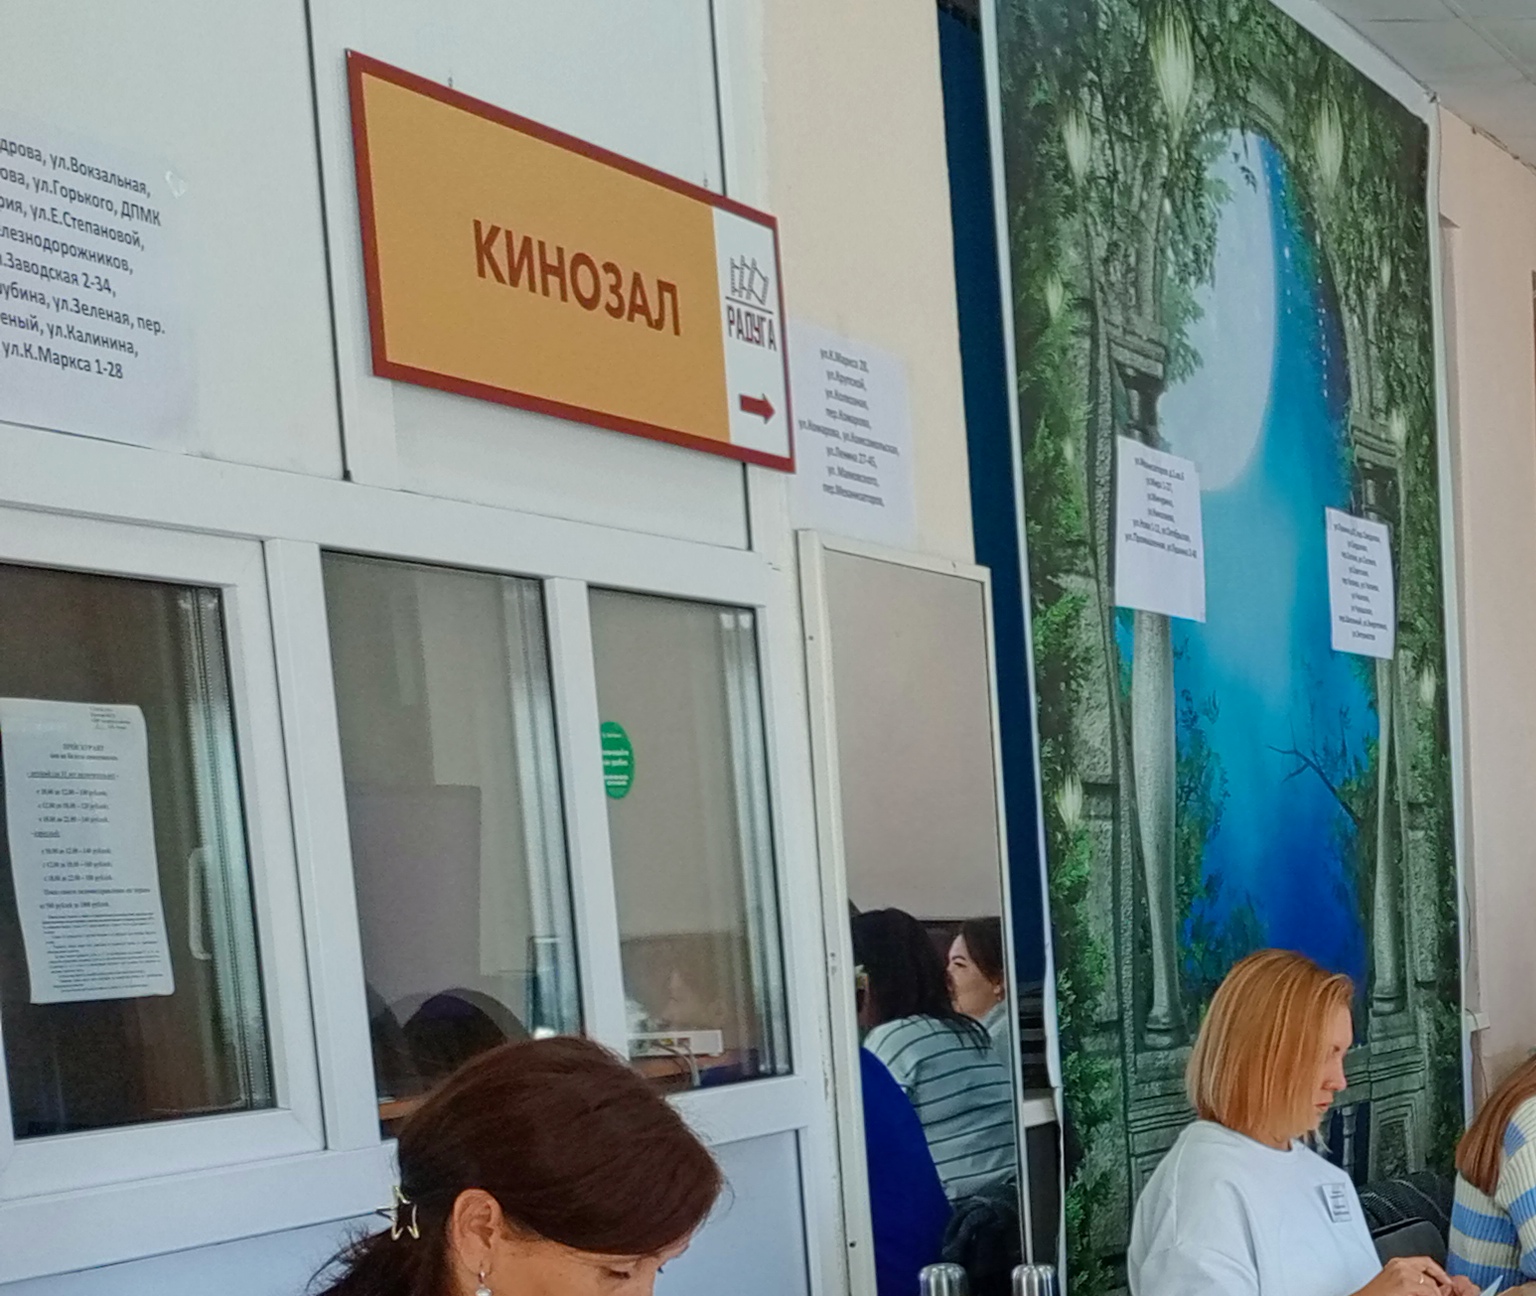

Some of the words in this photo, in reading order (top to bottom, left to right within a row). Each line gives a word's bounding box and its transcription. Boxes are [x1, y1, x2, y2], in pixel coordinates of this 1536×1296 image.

[50, 153, 151, 199] ул.Вокзальная,
[32, 176, 118, 217] ул.Горького,
[121, 200, 161, 226] ДПМК
[0, 225, 133, 275] лезнодорожников,
[30, 204, 145, 251] ул.Е.Степановой,
[0, 251, 79, 287] .Заводская
[81, 271, 116, 298] 2-34,
[473, 218, 681, 336] КИНОЗАЛ
[0, 281, 50, 309] убина,
[52, 295, 135, 330] ул.Зеленая,
[137, 316, 165, 336] пер.
[725, 304, 777, 352] РАДУГА
[2, 341, 91, 371] ул.К.Маркса
[95, 358, 123, 379] 1-28
[46, 322, 139, 358] ул.Калинина,
